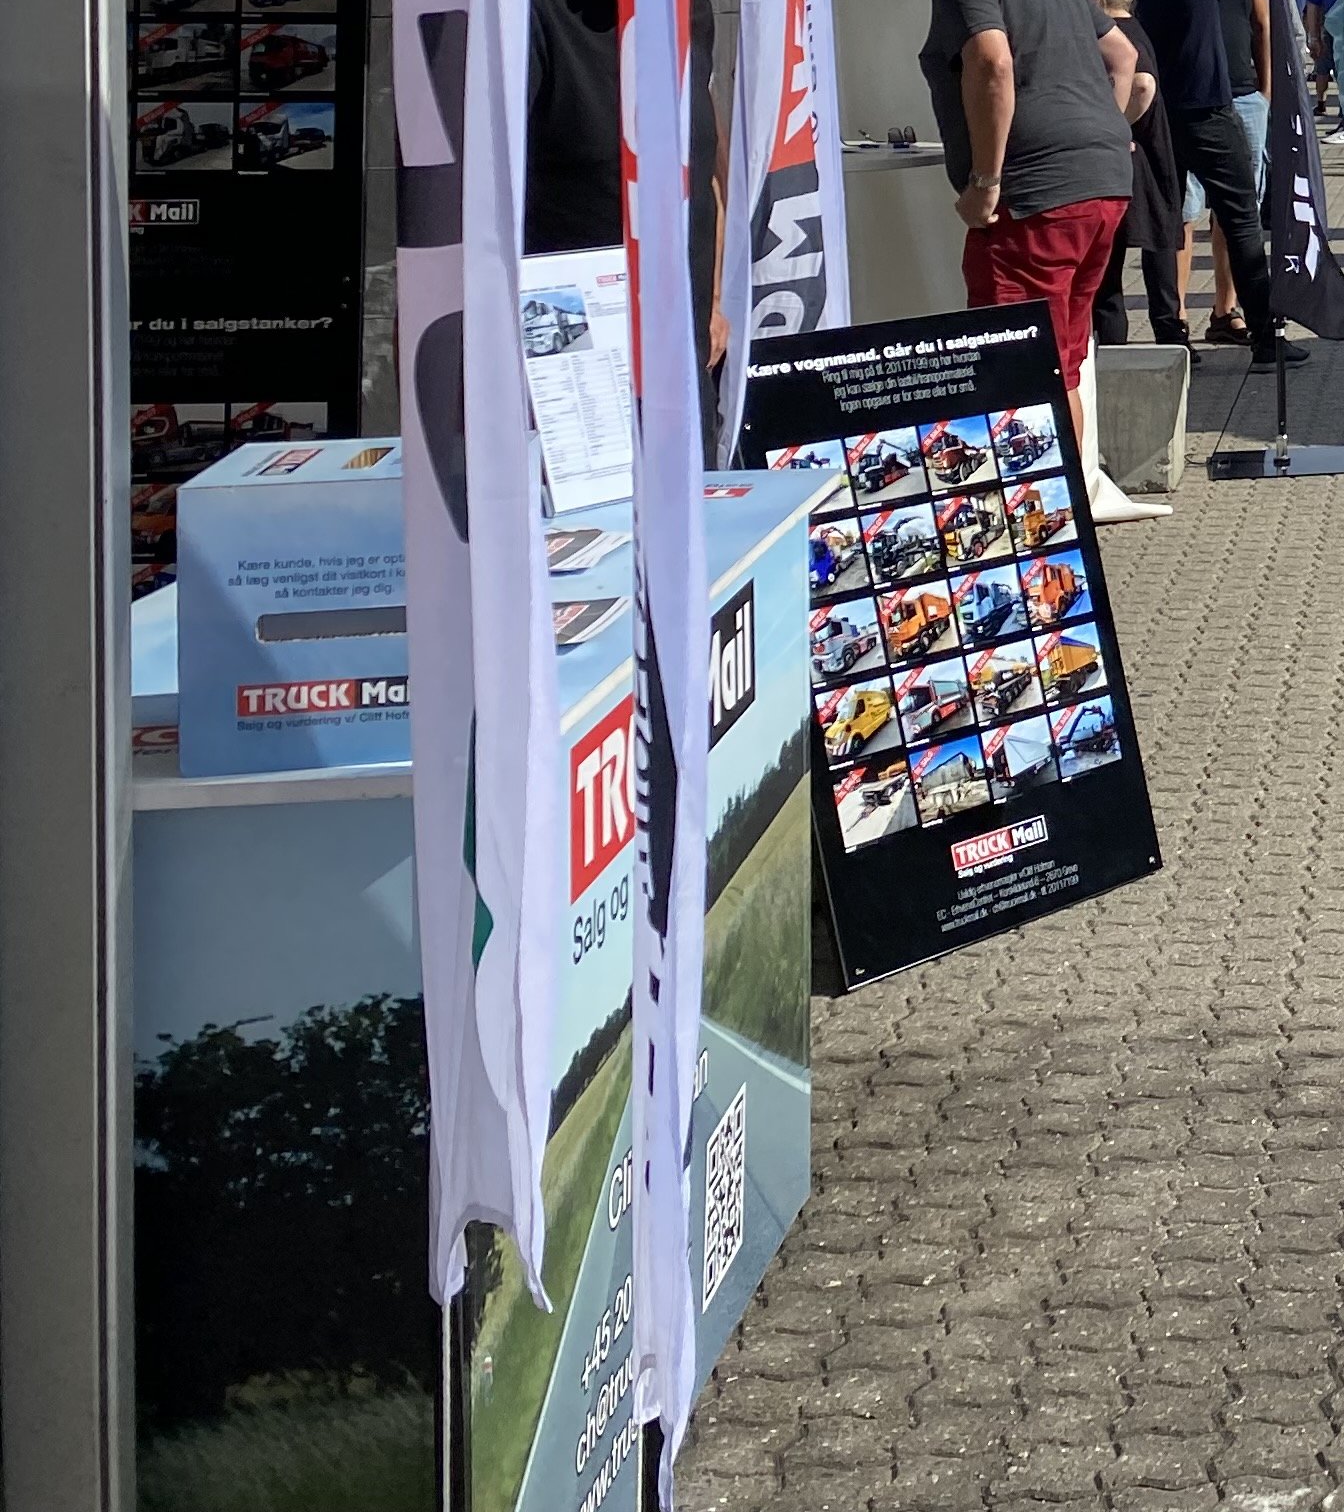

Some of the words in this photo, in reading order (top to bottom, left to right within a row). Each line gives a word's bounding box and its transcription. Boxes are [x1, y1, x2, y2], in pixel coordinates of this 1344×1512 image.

[150, 203, 194, 221] Mail
[149, 318, 175, 331] du
[193, 317, 334, 333] salgstanker?
[747, 358, 791, 379] Kære
[794, 349, 880, 372] vognmand.
[884, 343, 912, 360] Går
[915, 341, 934, 355] du
[946, 326, 1039, 350] salgstanker?
[238, 560, 270, 571] Kære
[274, 558, 315, 570] kunde,
[319, 555, 343, 566] hvis
[346, 555, 364, 568] jeg
[368, 555, 381, 565] er
[228, 575, 242, 586] så
[246, 575, 269, 588] læg
[272, 572, 319, 586] venligst
[322, 569, 337, 581] dit
[340, 567, 386, 580] visitkort
[275, 588, 289, 599] så
[292, 585, 348, 598] kontakter
[351, 584, 370, 597] jeg
[374, 582, 395, 594] dig.
[242, 682, 350, 714] TRUCK
[361, 678, 409, 705] Ma
[266, 720, 282, 732] og
[286, 715, 341, 729] vurdering
[360, 712, 382, 723] Cliff
[956, 832, 1010, 865] TRUCK
[1011, 820, 1044, 847] Mail
[573, 898, 606, 966] Salg
[610, 873, 630, 923] og
[580, 1318, 612, 1393] +45
